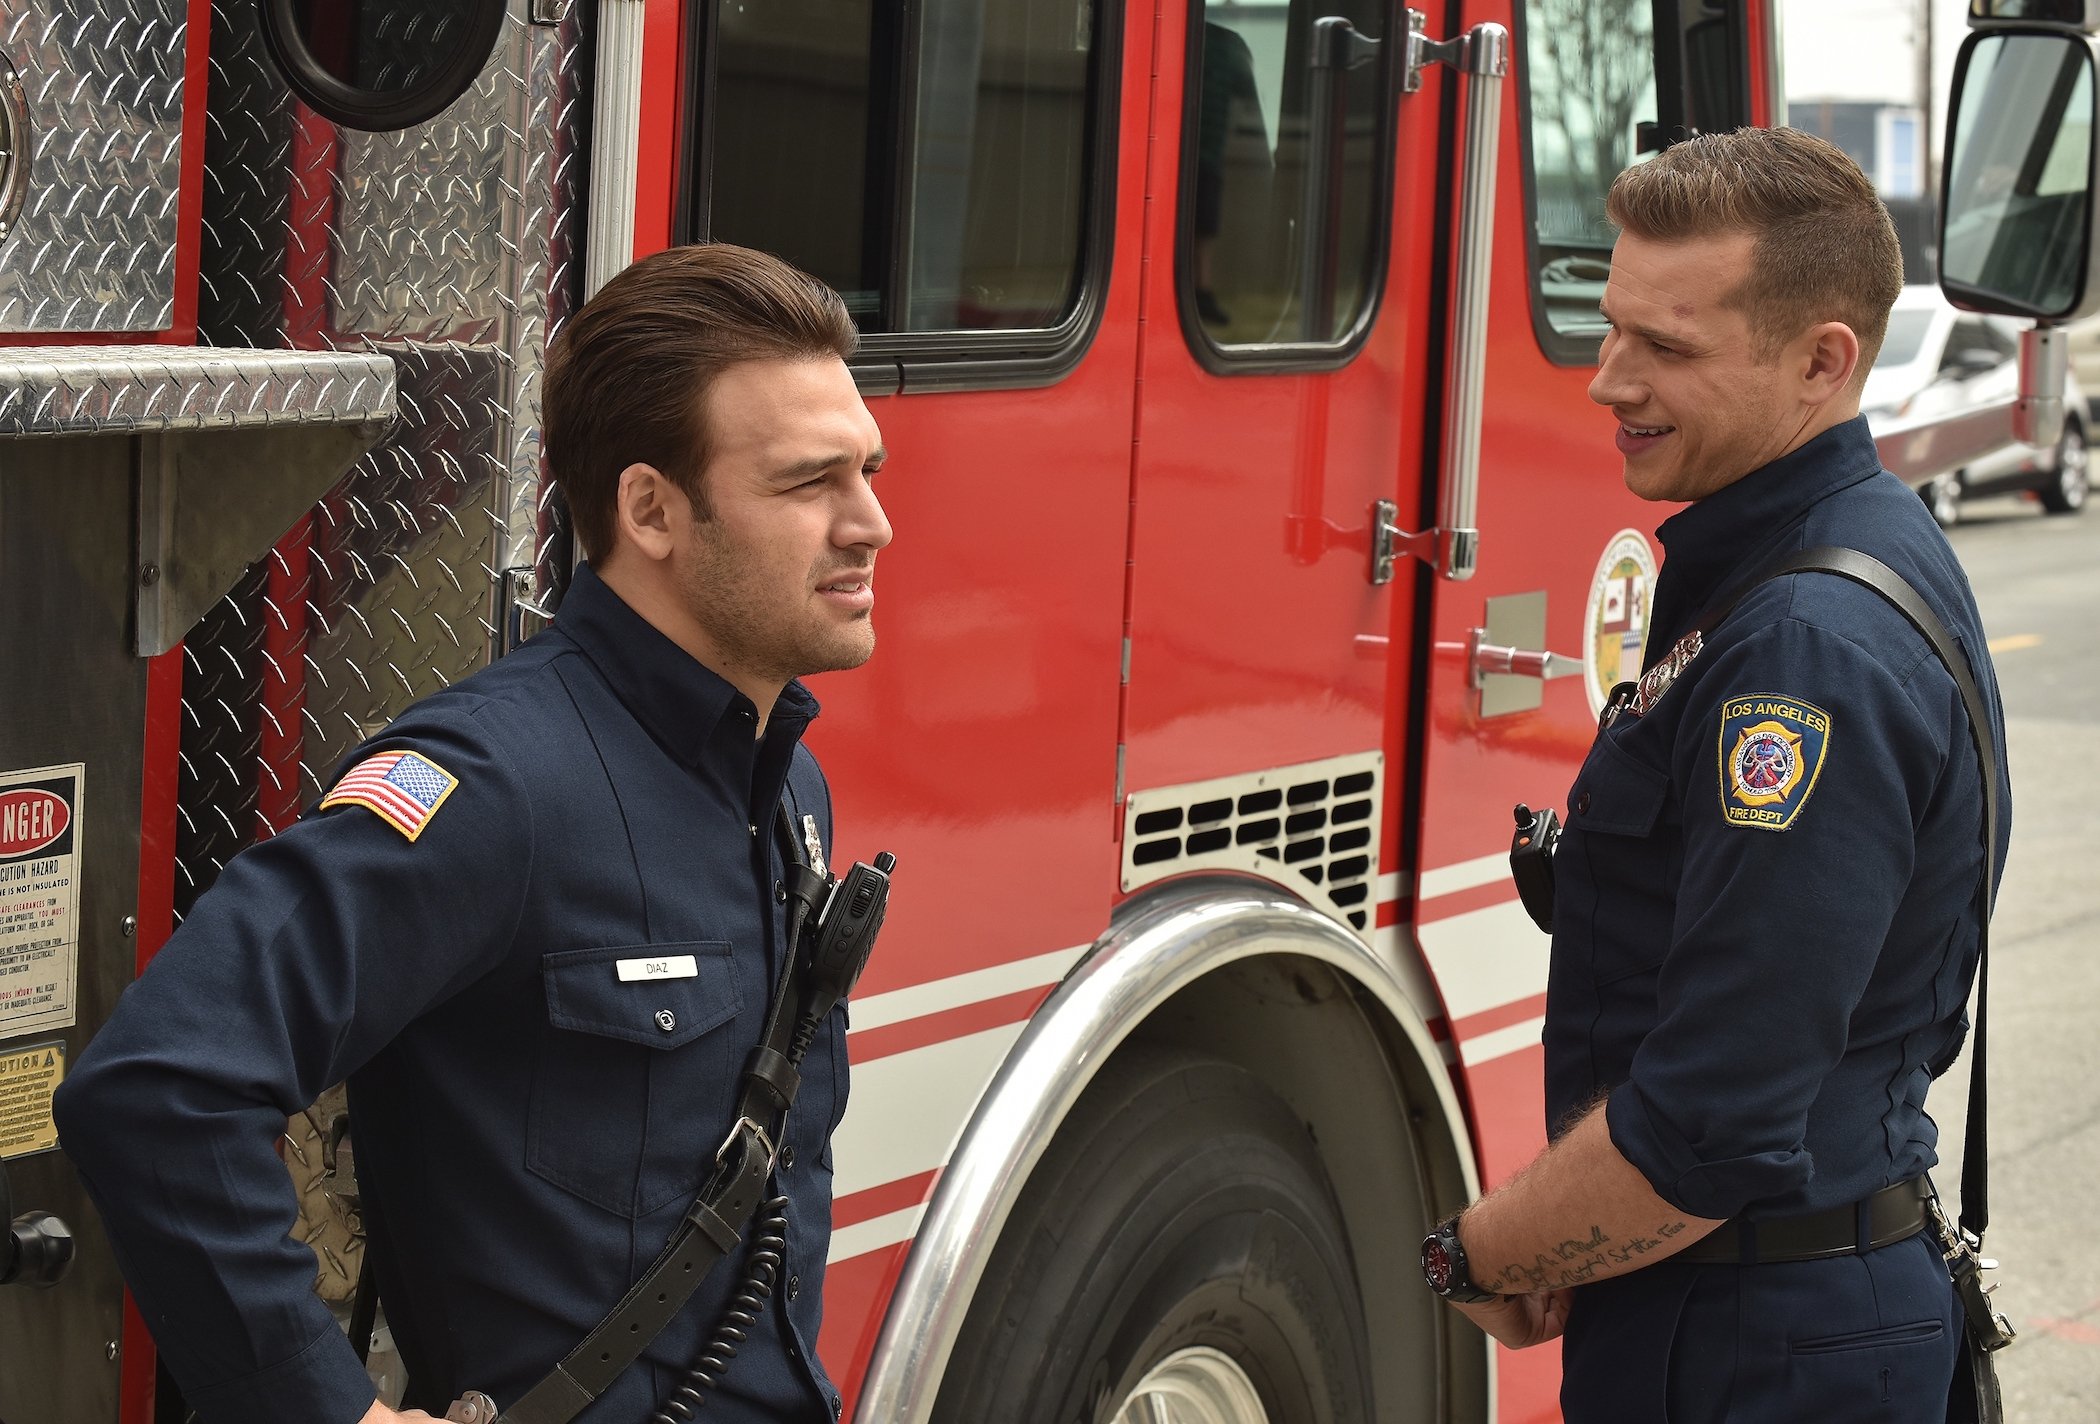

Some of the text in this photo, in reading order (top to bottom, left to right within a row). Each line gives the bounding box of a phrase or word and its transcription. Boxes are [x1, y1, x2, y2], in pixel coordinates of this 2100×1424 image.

[1726, 702, 1826, 733] LOS ANGELES
[3, 799, 54, 844] NGER
[1729, 806, 1784, 824] FIRE DEPT
[0, 859, 59, 882] CUTION HAZARD
[8, 887, 15, 896] IS
[16, 884, 31, 894] NOT
[32, 878, 69, 892] INSULATED
[13, 900, 45, 912] CLEARANCES
[39, 910, 49, 918] YOU
[51, 907, 65, 916] MUST
[646, 962, 668, 974] DIAZ
[0, 1055, 39, 1074] UTION
